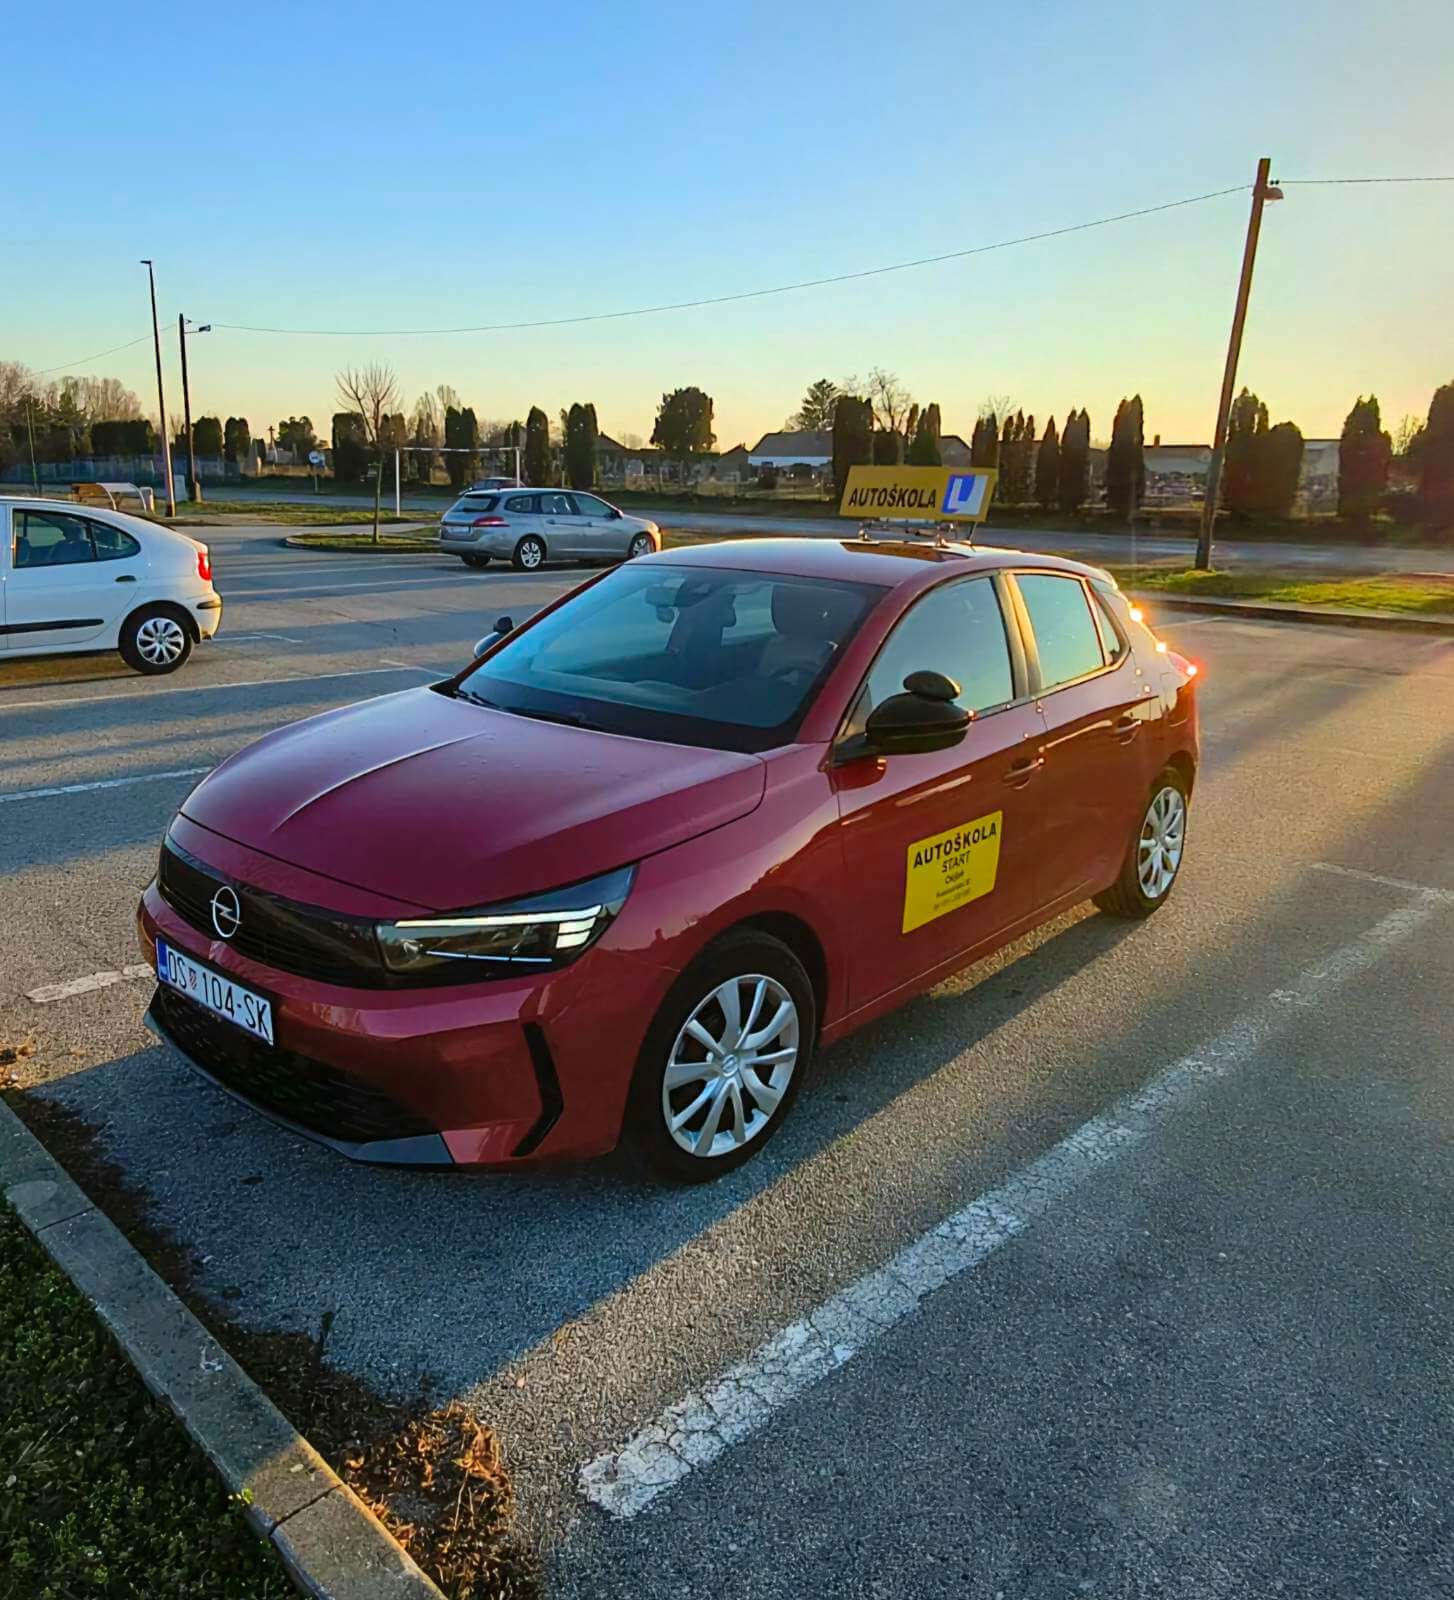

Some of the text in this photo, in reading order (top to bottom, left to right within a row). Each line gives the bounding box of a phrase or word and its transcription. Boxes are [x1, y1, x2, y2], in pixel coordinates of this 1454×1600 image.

[848, 484, 936, 509] AUTOŠKOLA
[913, 822, 997, 869] AUTOŠKOLA
[941, 850, 971, 873] START
[168, 950, 272, 1042] OS 104-SK
